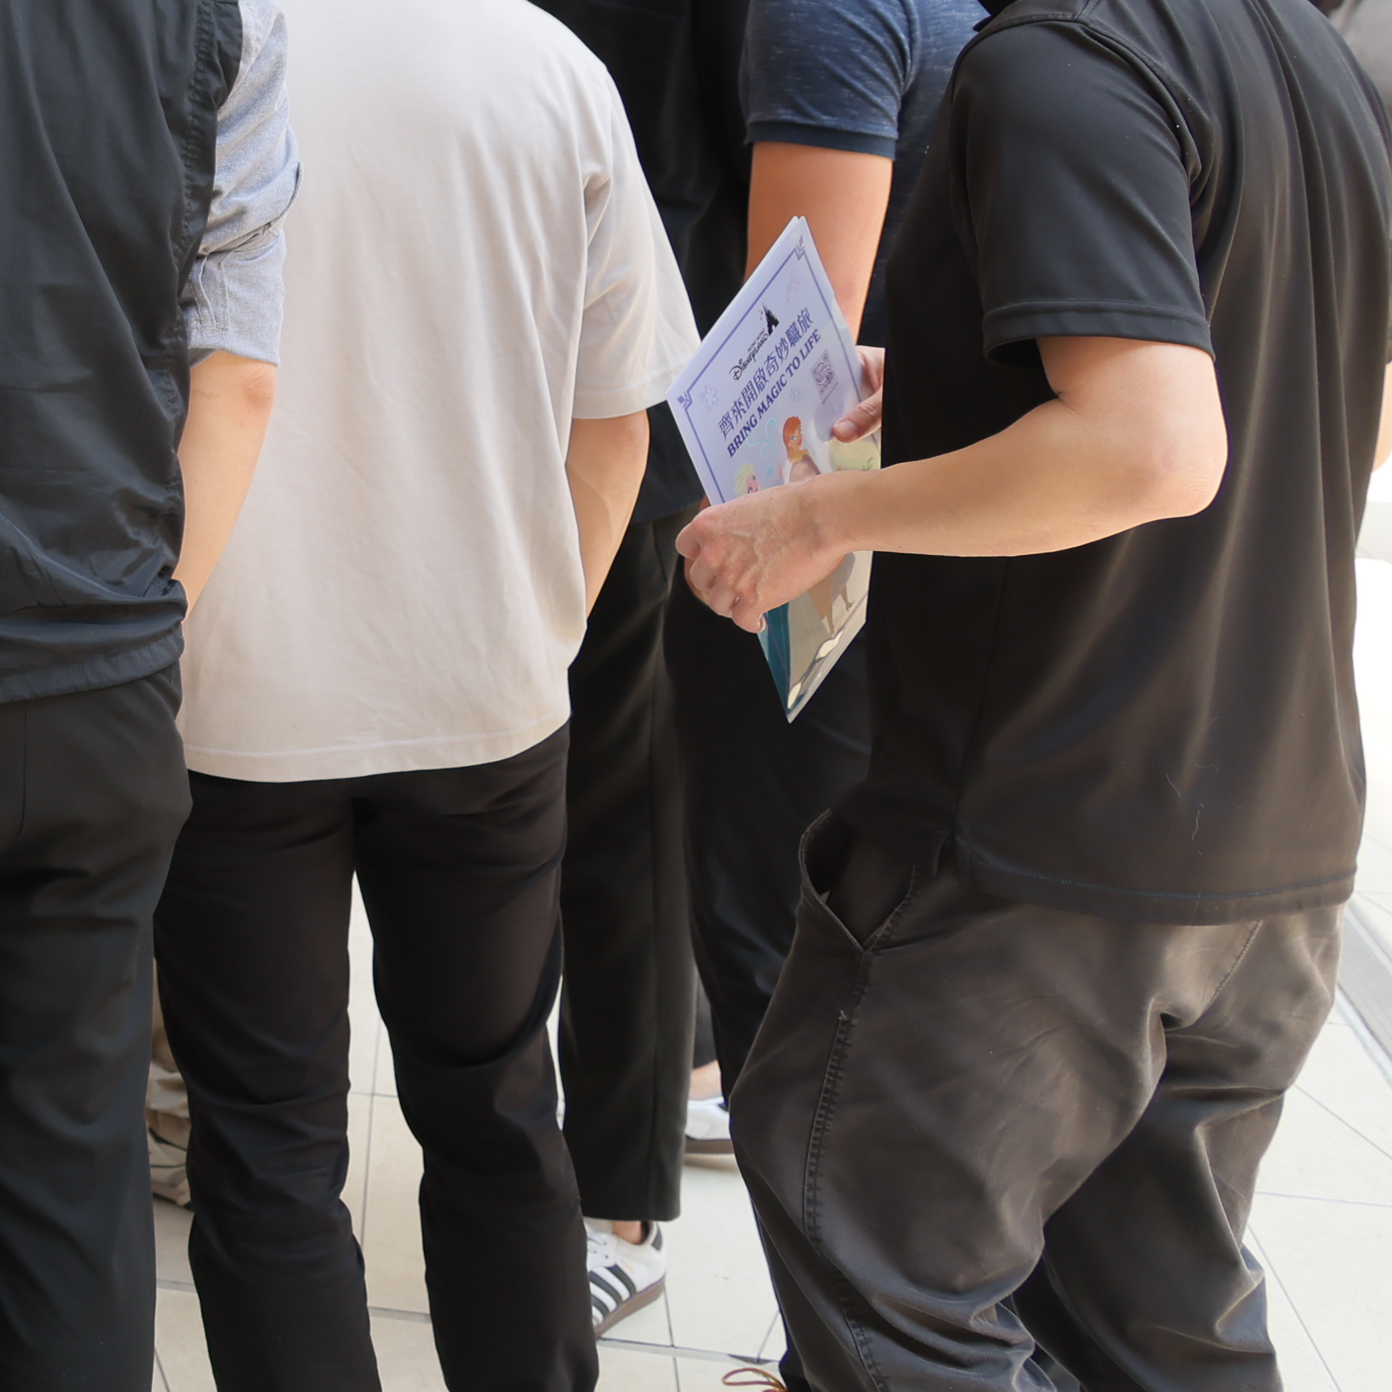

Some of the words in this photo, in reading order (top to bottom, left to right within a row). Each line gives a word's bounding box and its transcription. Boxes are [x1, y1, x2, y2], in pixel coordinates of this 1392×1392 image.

[727, 414, 758, 457] BRING
[758, 374, 788, 420] MAGIC
[785, 356, 801, 377] TO
[802, 329, 821, 360] LIFE
